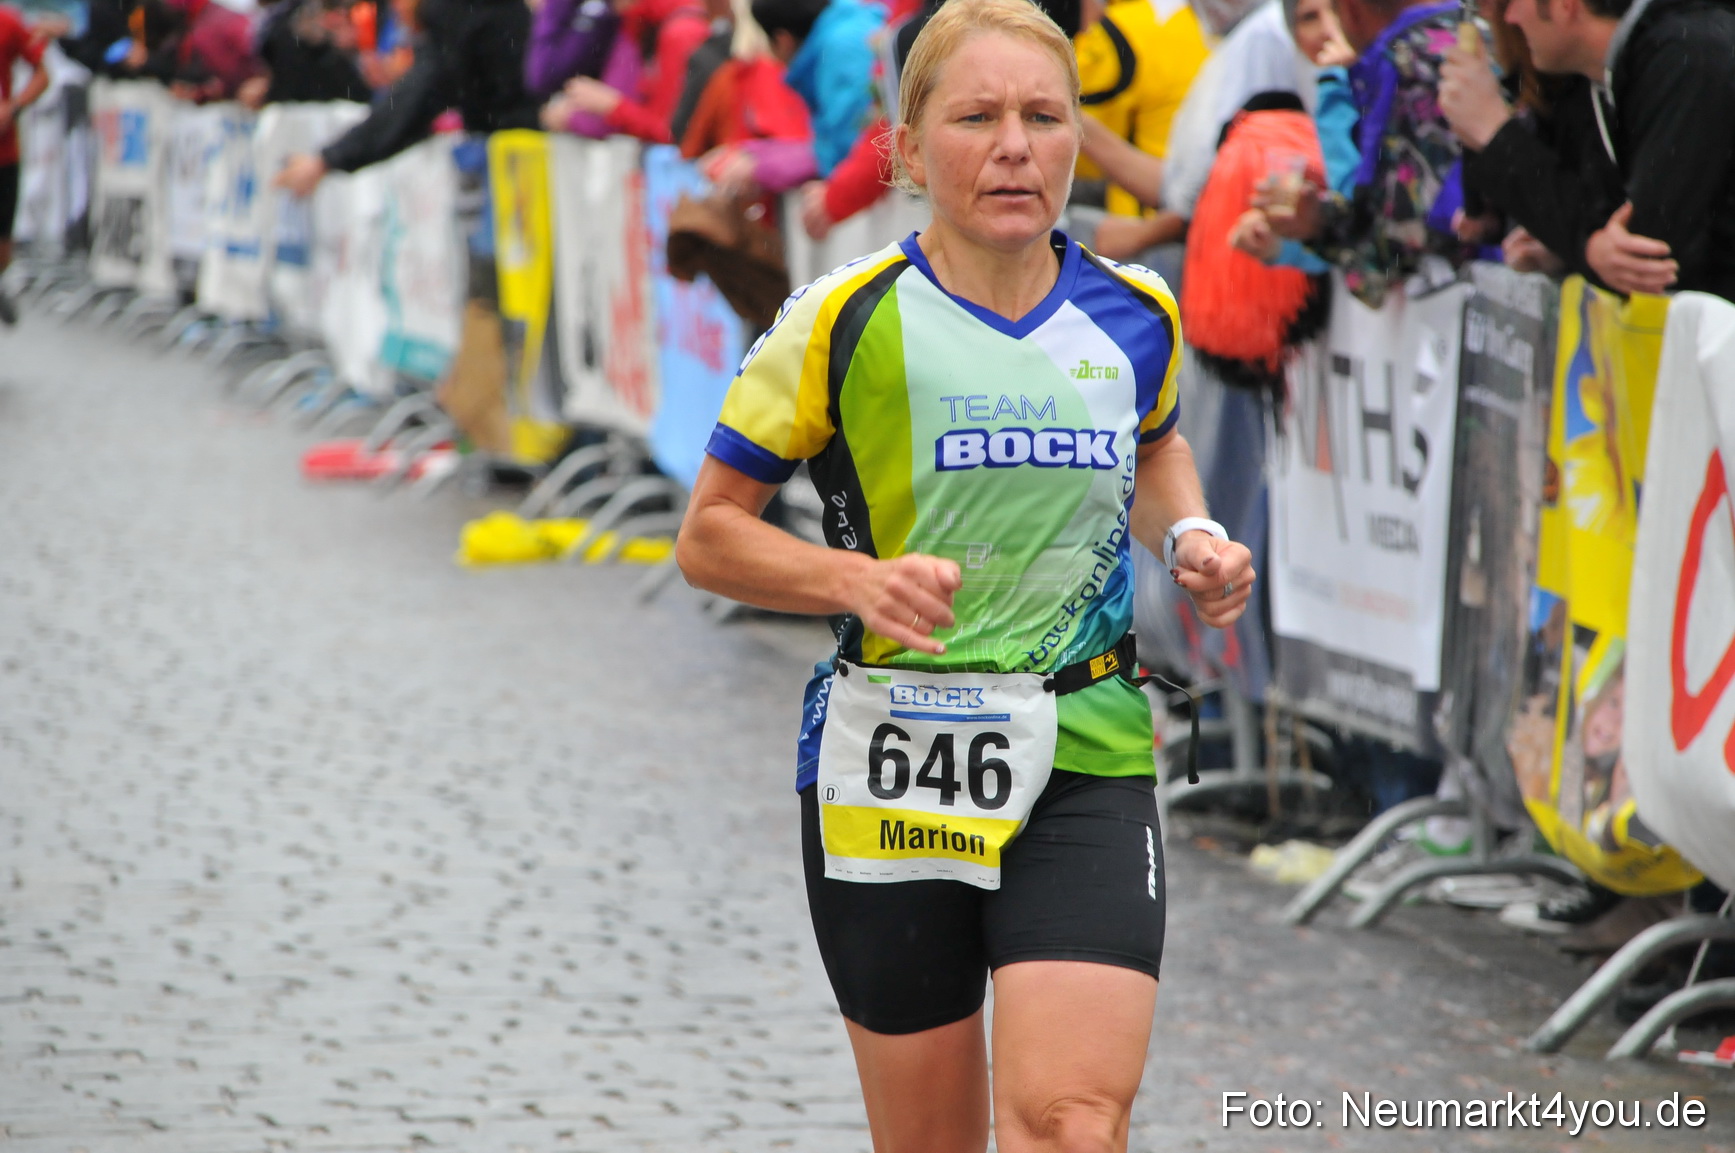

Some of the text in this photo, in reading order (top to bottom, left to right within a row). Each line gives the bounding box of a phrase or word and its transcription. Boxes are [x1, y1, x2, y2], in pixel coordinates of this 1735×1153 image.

[940, 395, 1057, 423] TEAM
[935, 427, 1120, 472] BOCK
[890, 685, 985, 708] BOCK
[867, 723, 1012, 810] 646
[826, 788, 835, 801] D
[880, 819, 985, 857] Marion
